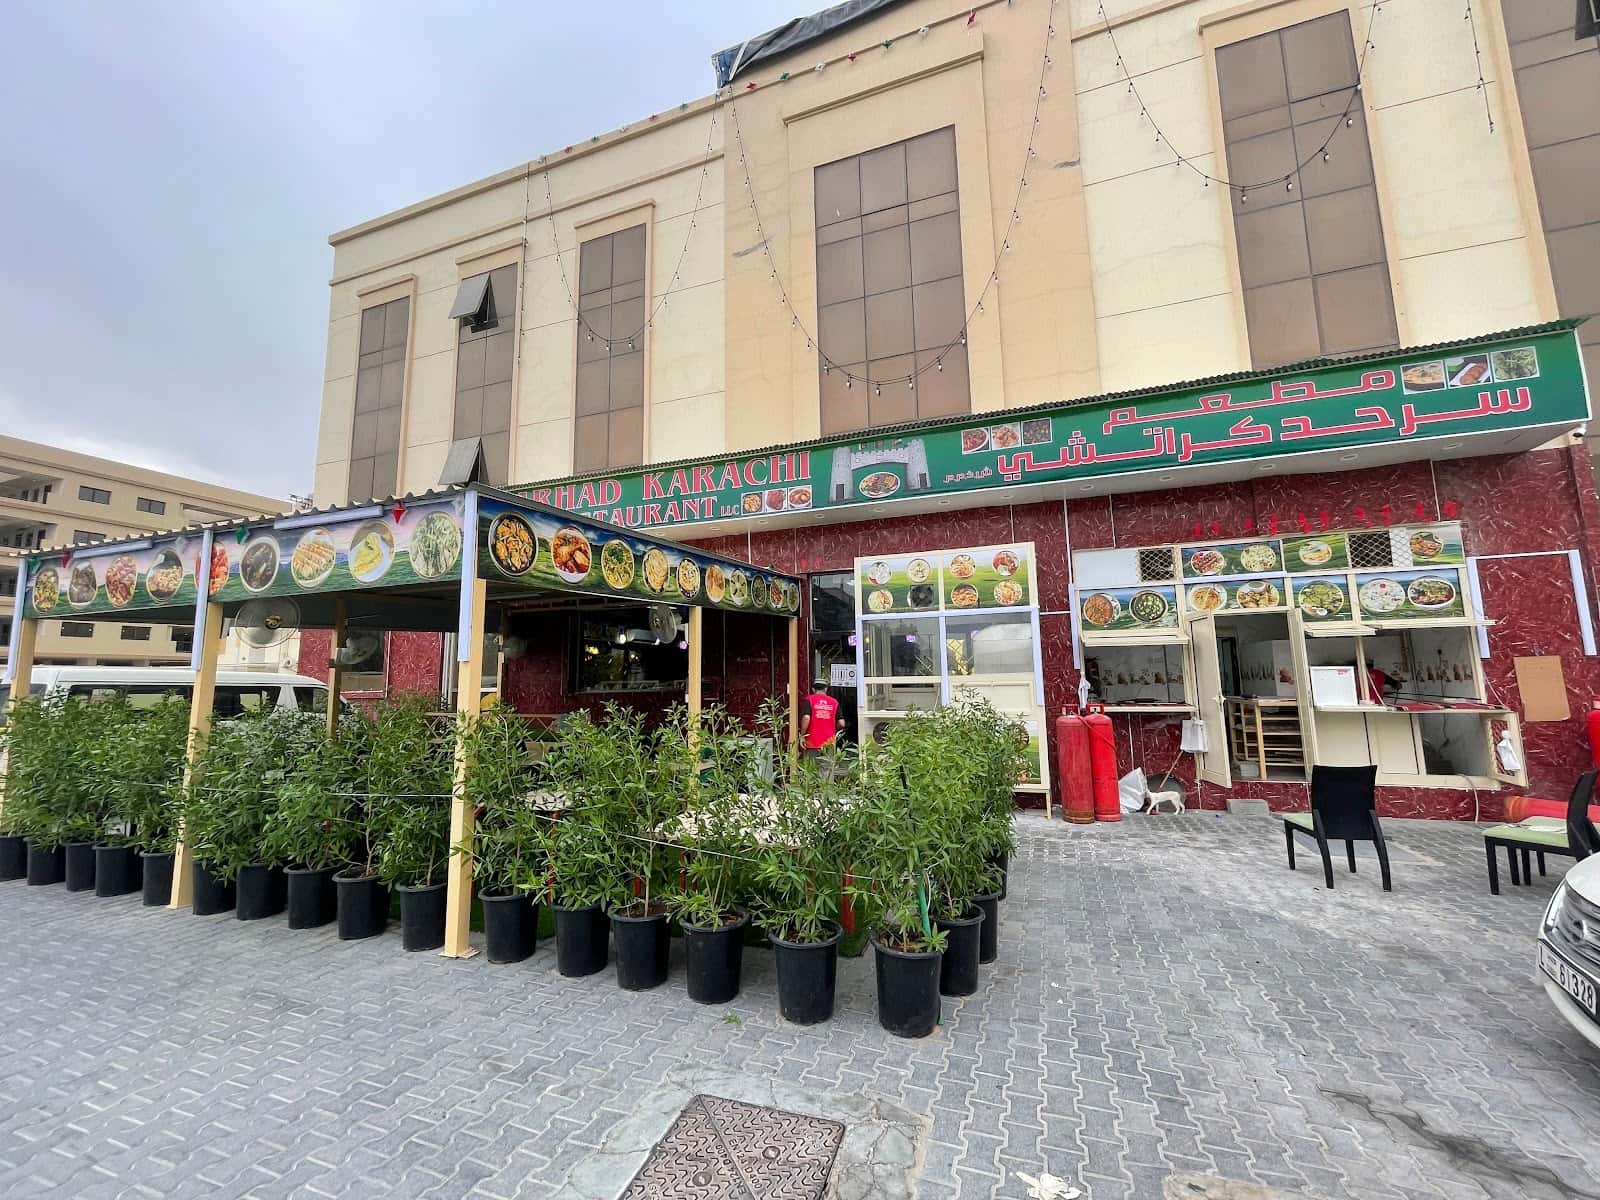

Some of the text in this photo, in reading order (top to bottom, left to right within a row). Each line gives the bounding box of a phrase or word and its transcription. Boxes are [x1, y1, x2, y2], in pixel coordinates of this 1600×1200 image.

[1102, 370, 1396, 435] مطعم
[518, 450, 812, 511] RHAD KARACHI
[581, 495, 718, 528] TAURANT
